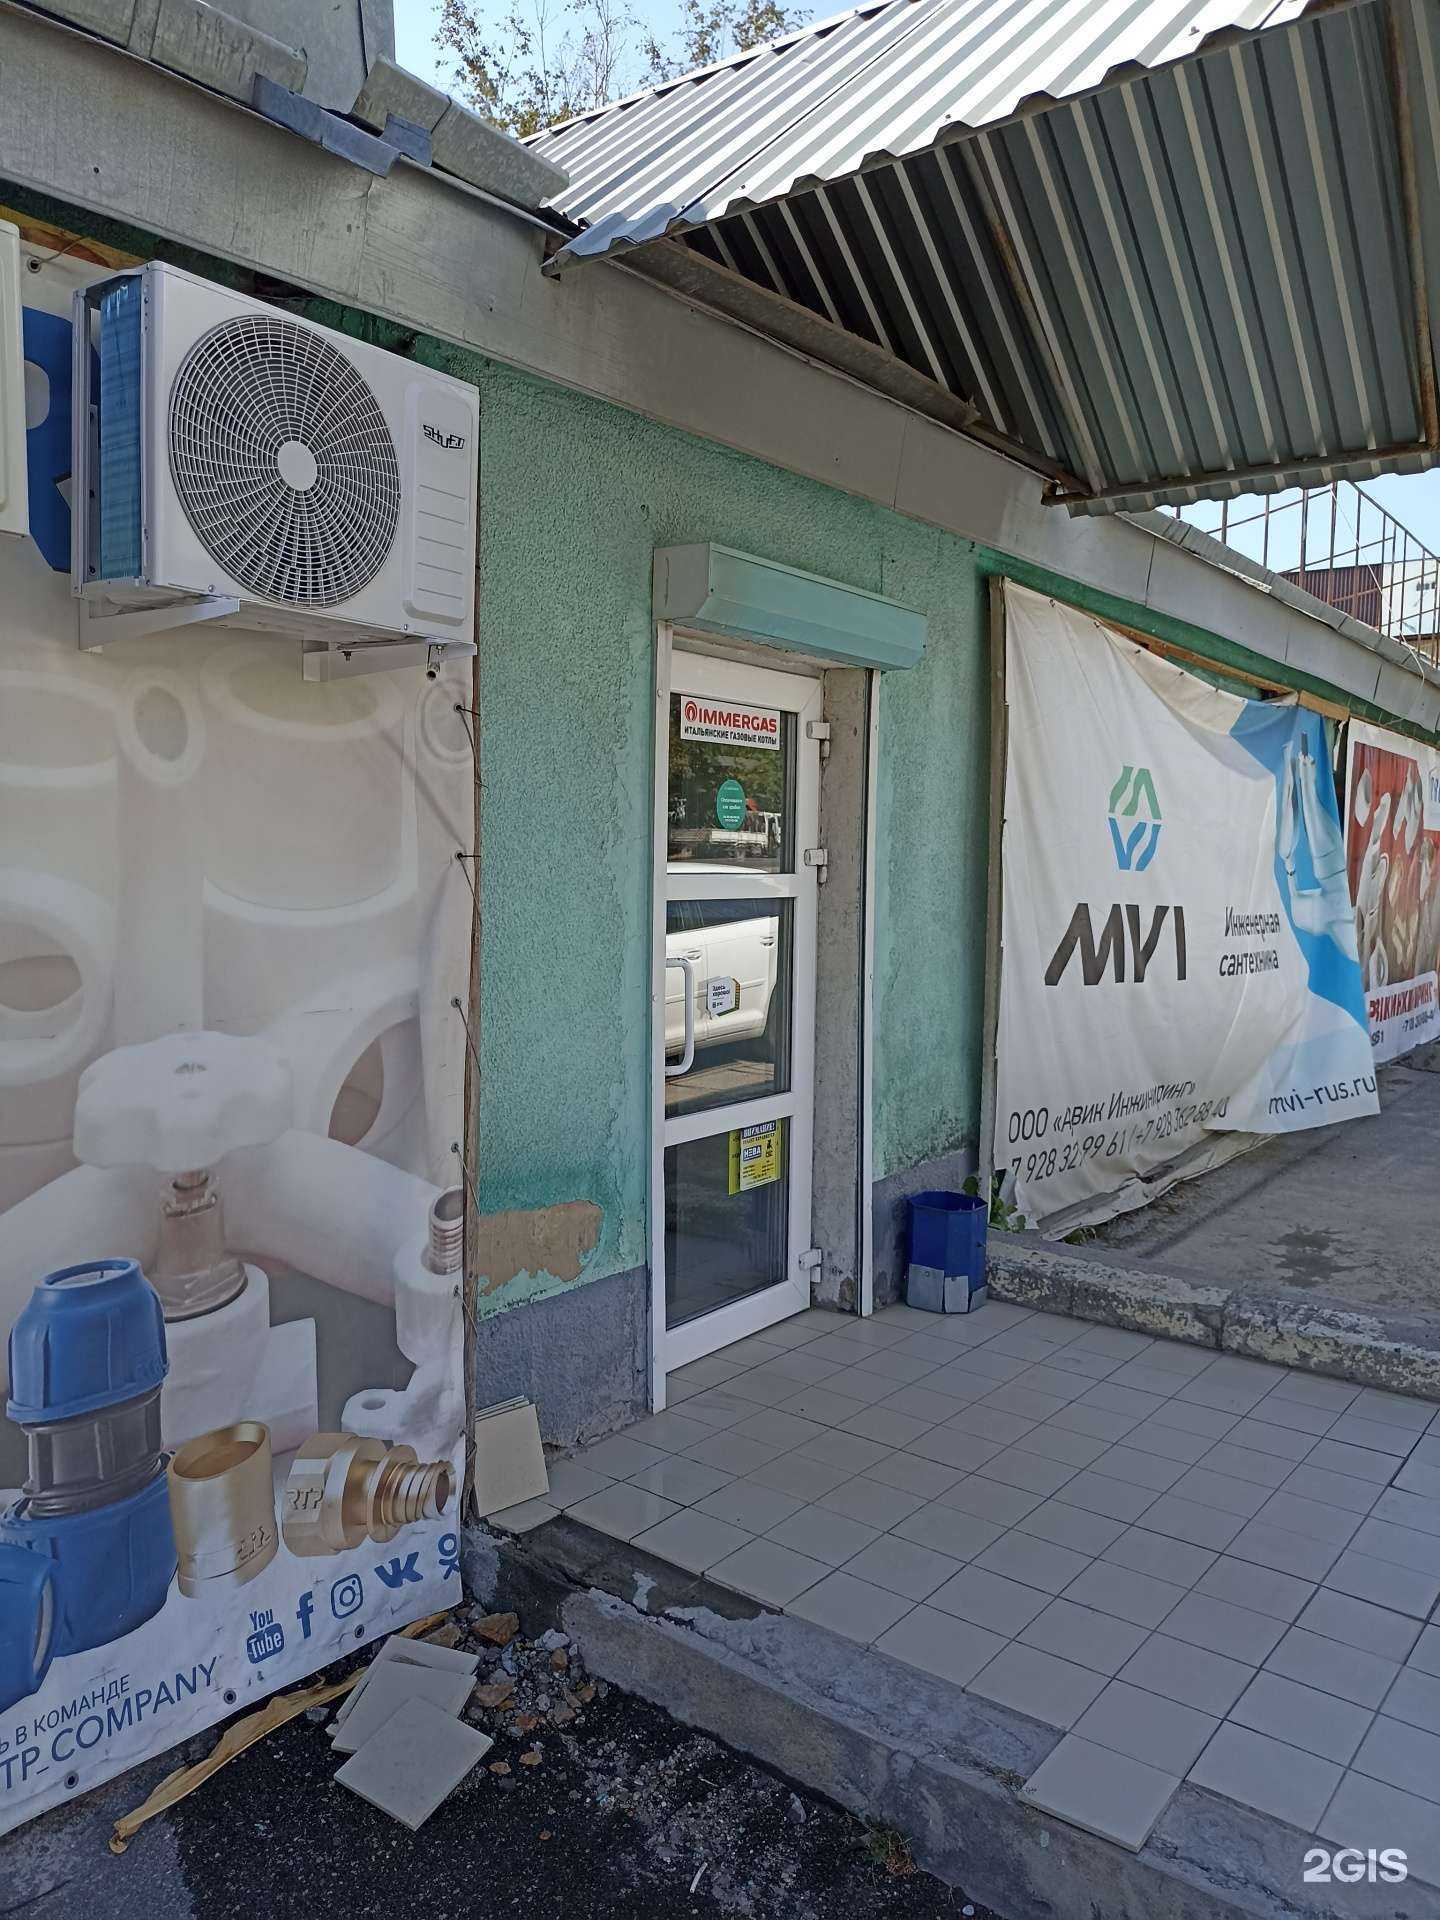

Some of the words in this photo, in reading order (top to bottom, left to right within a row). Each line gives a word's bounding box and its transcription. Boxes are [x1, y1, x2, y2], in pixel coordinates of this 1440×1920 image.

[423, 424, 465, 449] SHUFT
[684, 726, 729, 739] ИТАЛЬЯНСКИЕ
[729, 731, 757, 743] ГАЗОВЫЕ
[757, 735, 777, 744] КОТЛЫ
[698, 708, 777, 733] IMMERGAS
[1224, 906, 1281, 942] Инженерная
[1044, 903, 1187, 986] MVI
[1219, 949, 1279, 977] сантехника
[1268, 1075, 1377, 1114] mvi-rus.ru
[1008, 1107, 1049, 1144] ООО
[1026, 1149, 1057, 1183] 928
[1153, 1111, 1172, 1141] 928
[250, 1608, 273, 1632] You
[250, 1631, 283, 1659] Tube
[16, 1725, 28, 1746] В
[34, 1673, 131, 1737] КОМАНДЕ
